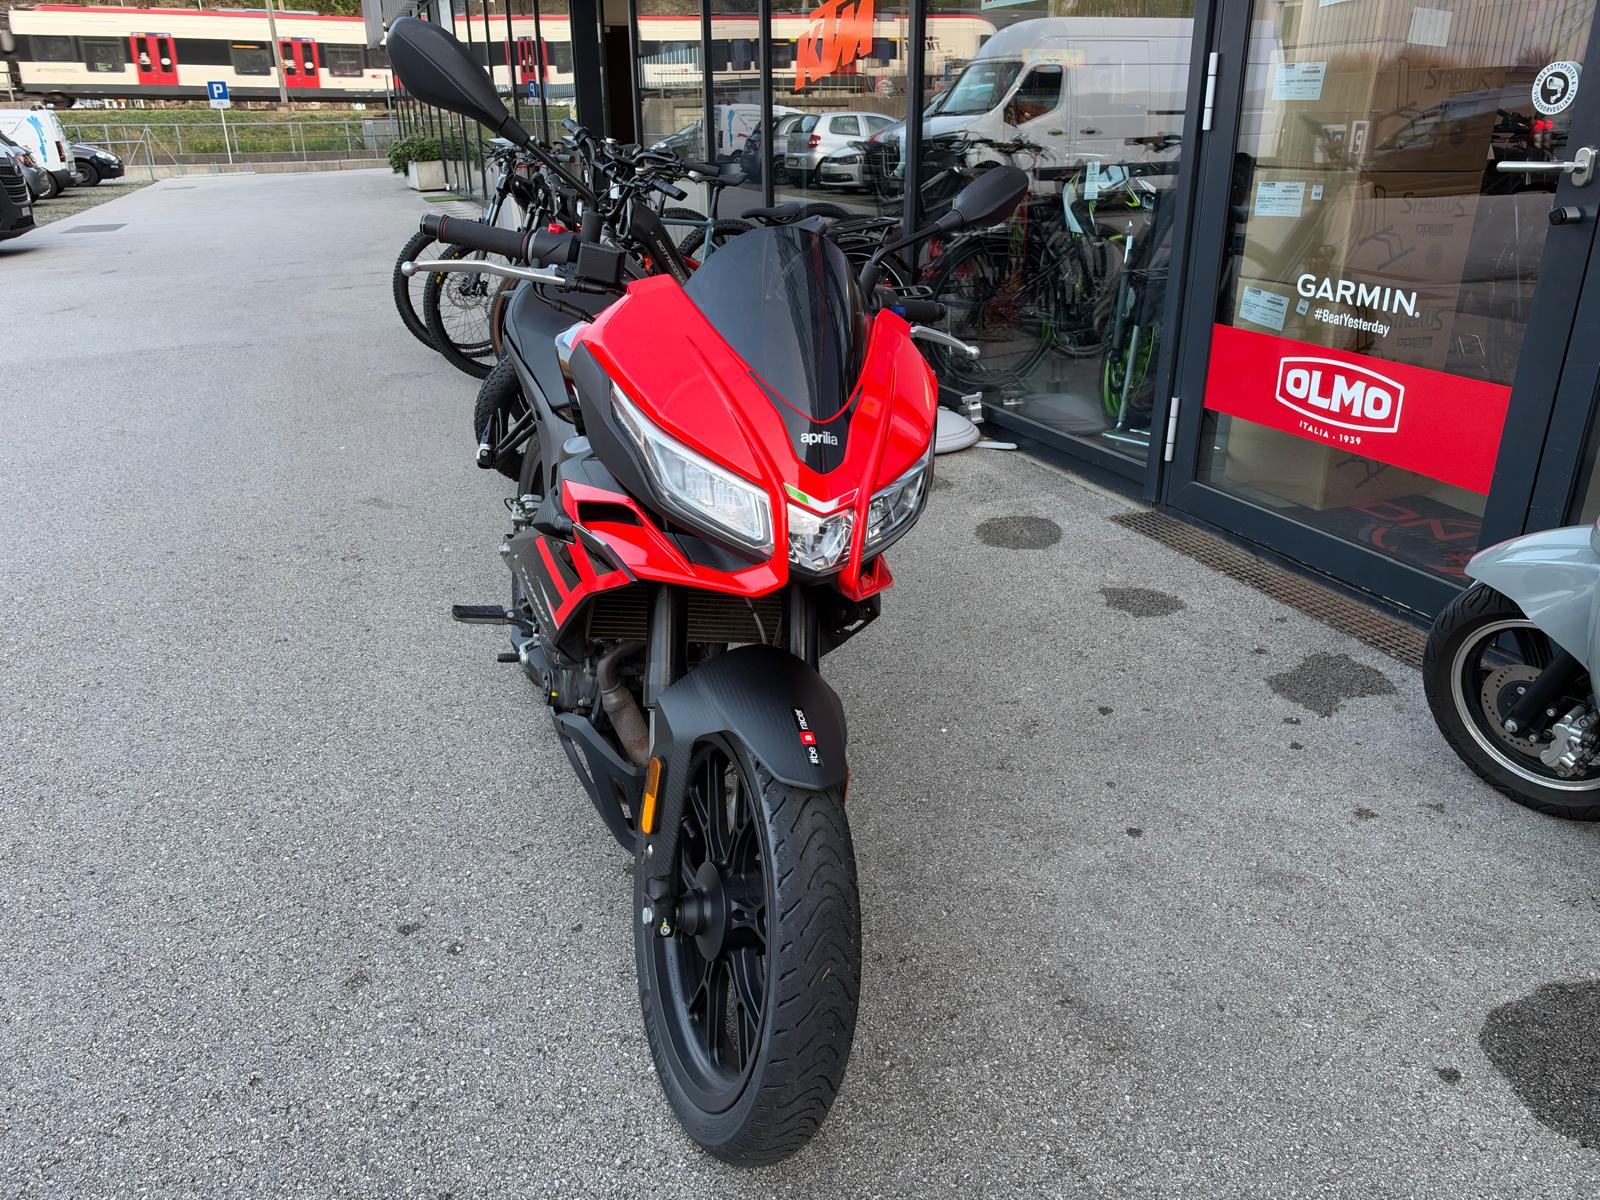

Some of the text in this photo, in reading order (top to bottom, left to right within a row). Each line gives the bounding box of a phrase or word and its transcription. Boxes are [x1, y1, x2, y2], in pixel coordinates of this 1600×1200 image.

[794, 0, 874, 92] KTM
[212, 83, 224, 98] P
[1535, 71, 1547, 87] AREA
[1296, 273, 1418, 317] GARMIN
[1313, 307, 1390, 338] #BeatYesterday
[1285, 368, 1392, 420] OLMO
[800, 430, 838, 446] aprilia
[1298, 420, 1361, 445] ITALIA 1939
[794, 708, 809, 730] racer
[808, 746, 820, 764] #be
